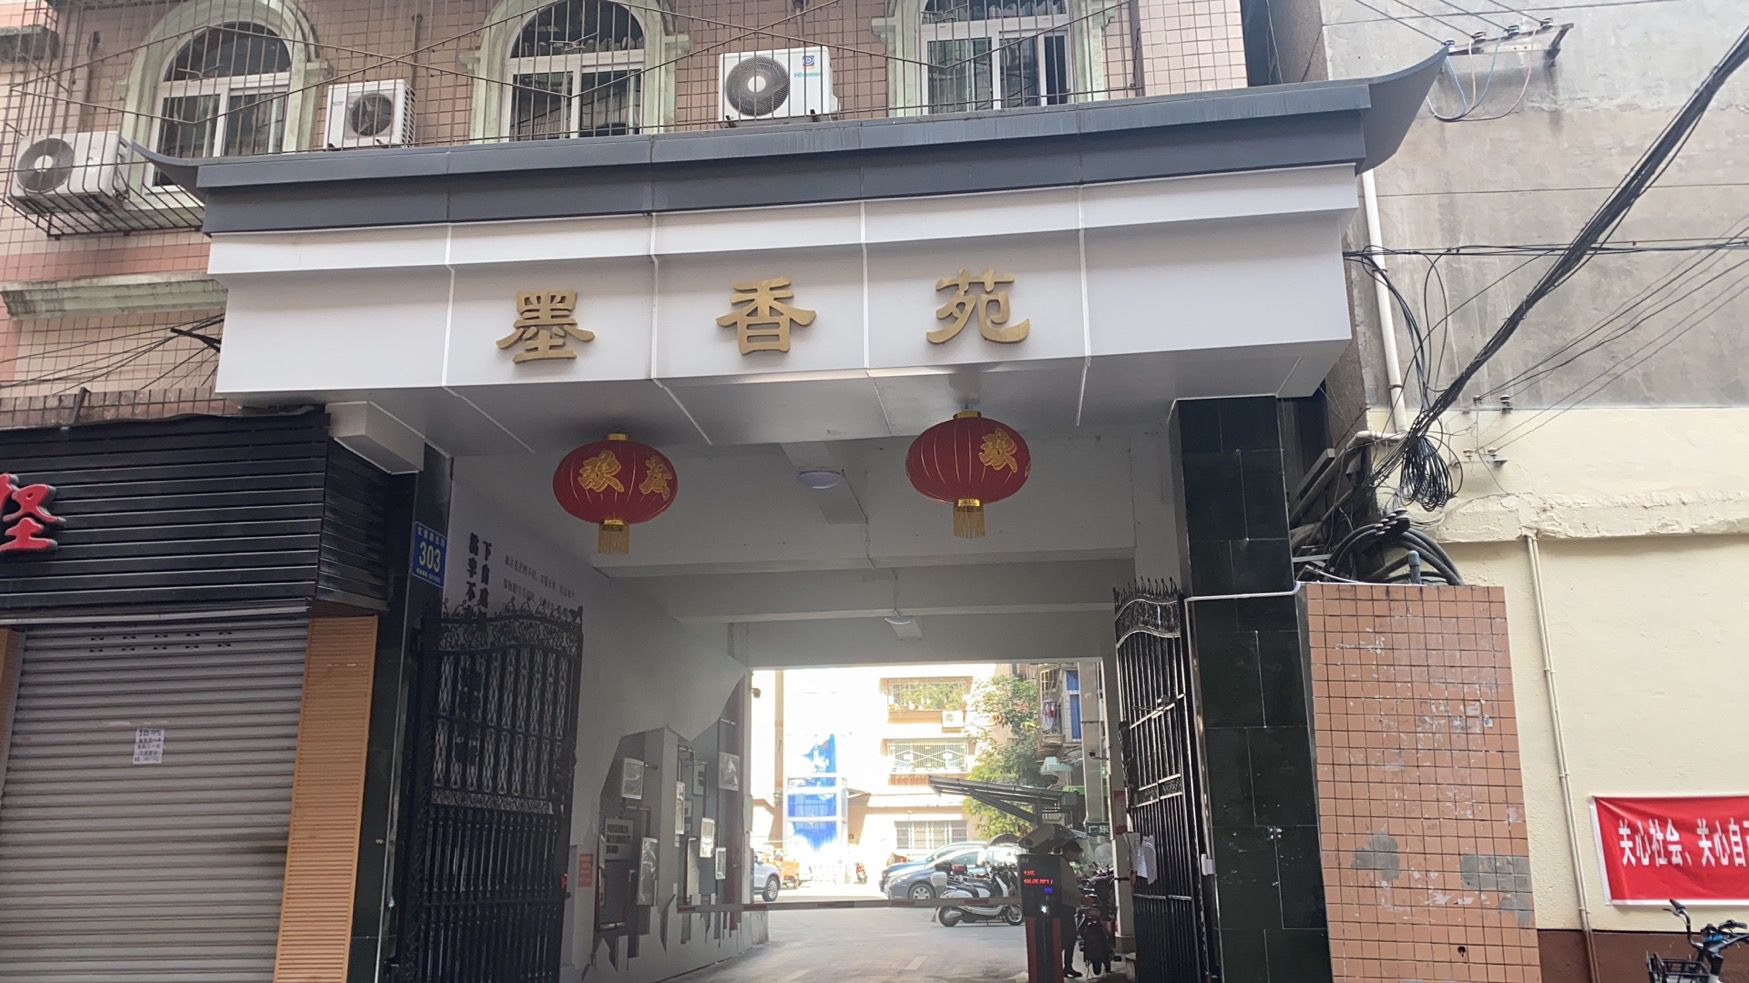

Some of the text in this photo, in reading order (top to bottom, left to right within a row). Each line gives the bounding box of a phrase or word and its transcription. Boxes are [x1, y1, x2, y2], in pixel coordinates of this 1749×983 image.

[496, 267, 1030, 364] 墨香苑
[418, 541, 442, 573] 303
[1618, 817, 1749, 868] 关心社会、关心自
